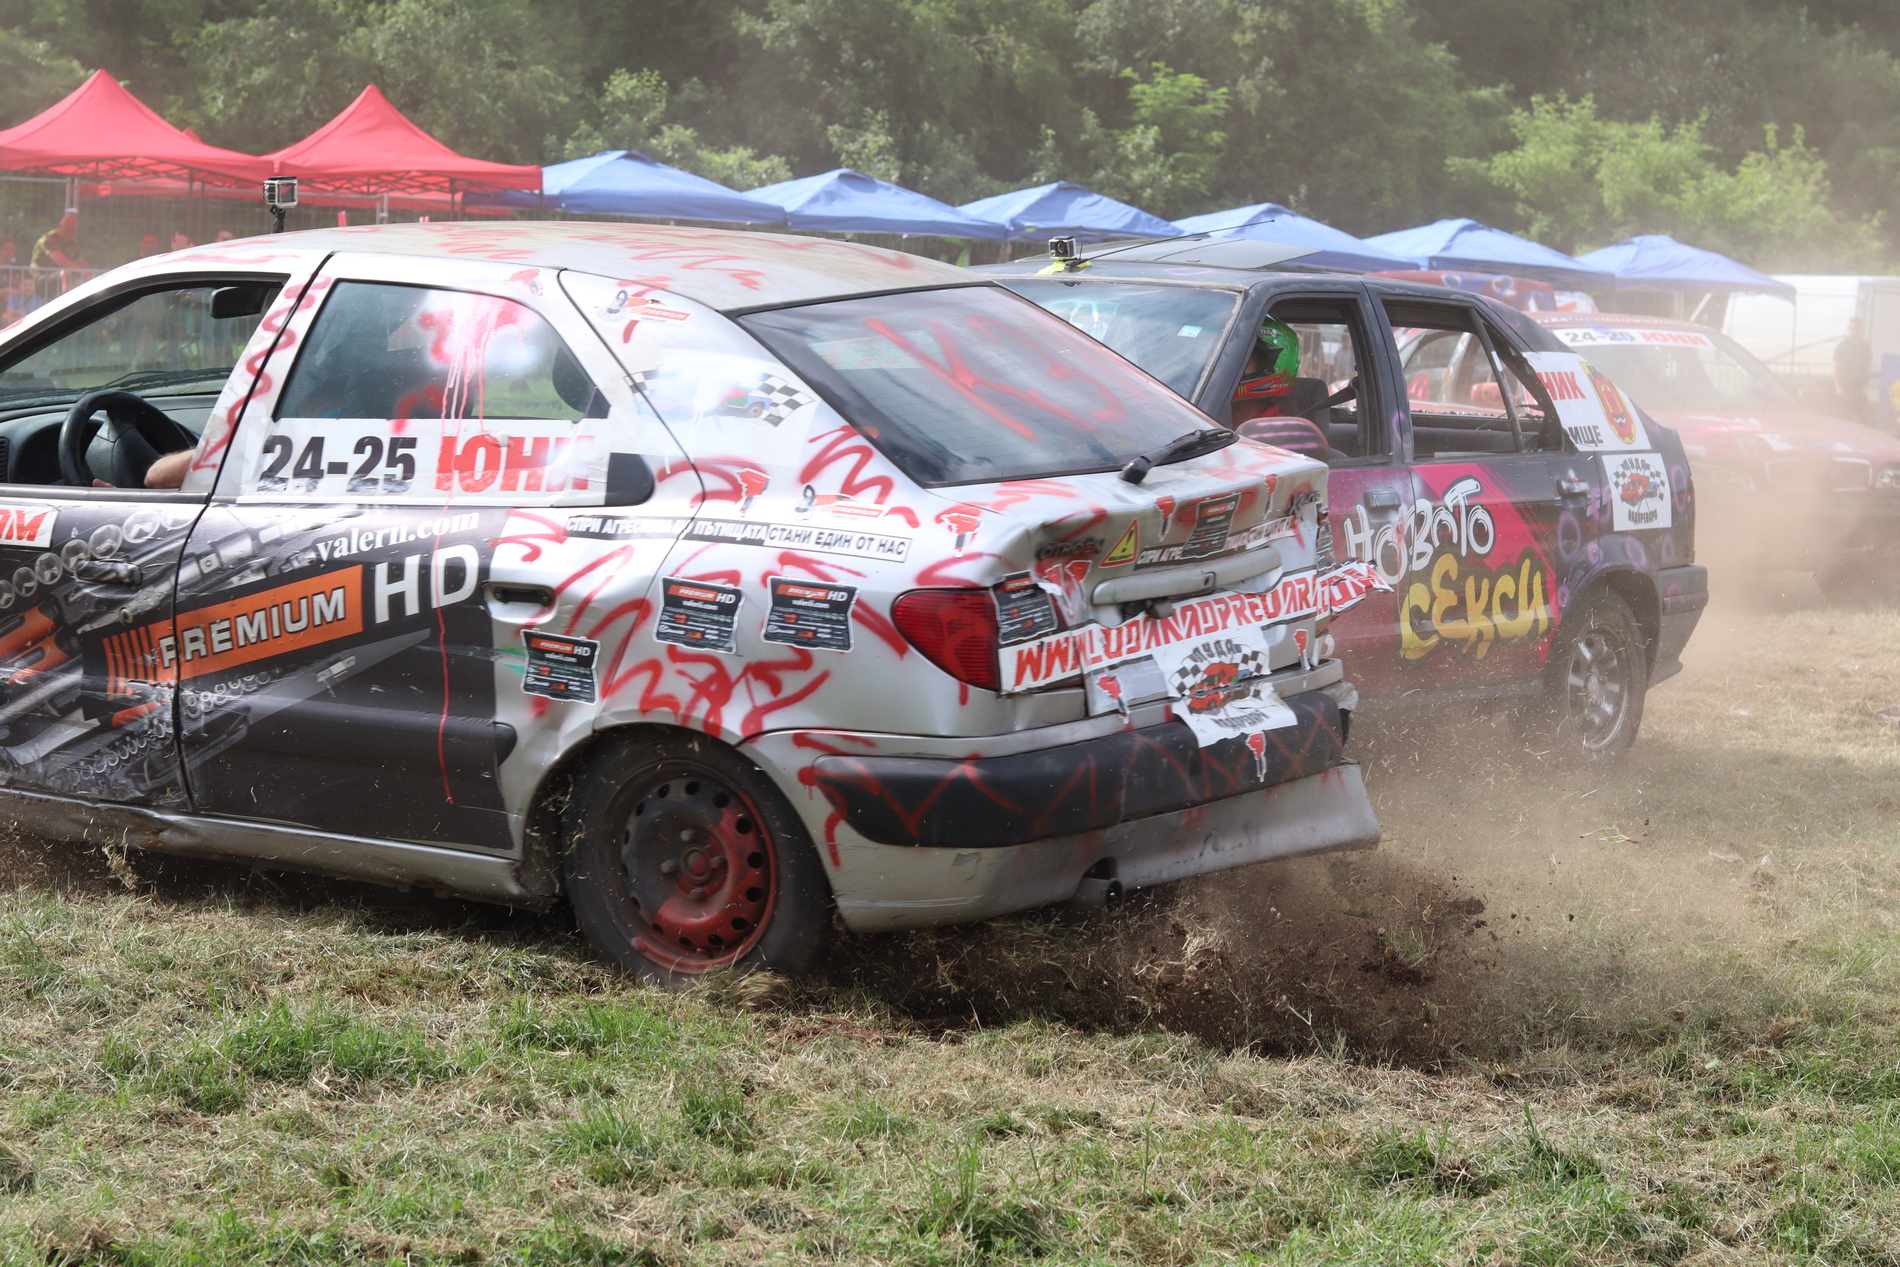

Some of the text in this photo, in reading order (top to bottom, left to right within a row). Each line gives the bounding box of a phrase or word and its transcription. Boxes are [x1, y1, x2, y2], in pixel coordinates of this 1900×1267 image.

[643, 307, 687, 319] PREMIUM
[1564, 330, 1709, 347] 24-25 ЮНИ
[256, 435, 418, 493] 24-25
[315, 511, 480, 562] valerii.com
[566, 516, 603, 533] СПРИ
[693, 521, 768, 541] ПЪТИЩАТА
[769, 527, 813, 544] СТАНИ
[814, 531, 854, 549] ЕДИН
[856, 536, 876, 551] ОТ
[877, 538, 907, 556] НАС
[715, 592, 736, 604] HD
[826, 590, 848, 602] HD
[159, 543, 480, 669] PREMIUM HD
[573, 645, 592, 657] HD
